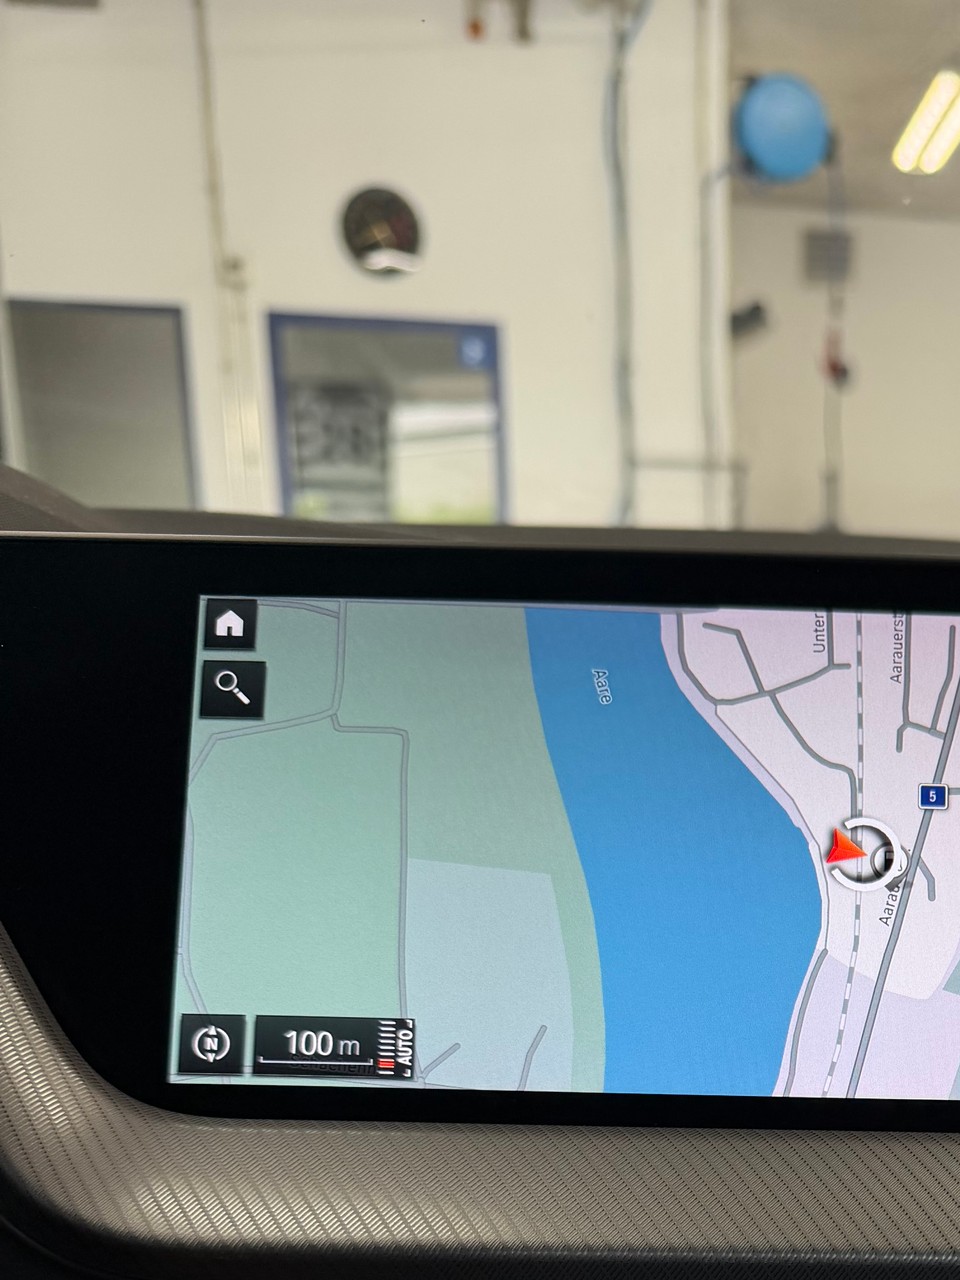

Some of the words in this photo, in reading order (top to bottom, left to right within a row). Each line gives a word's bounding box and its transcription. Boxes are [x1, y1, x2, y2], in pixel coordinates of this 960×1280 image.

[813, 612, 826, 653] Unter
[593, 669, 612, 704] Aare
[284, 1030, 334, 1056] 100
[339, 1039, 360, 1056] m
[397, 1030, 413, 1066] AUTO
